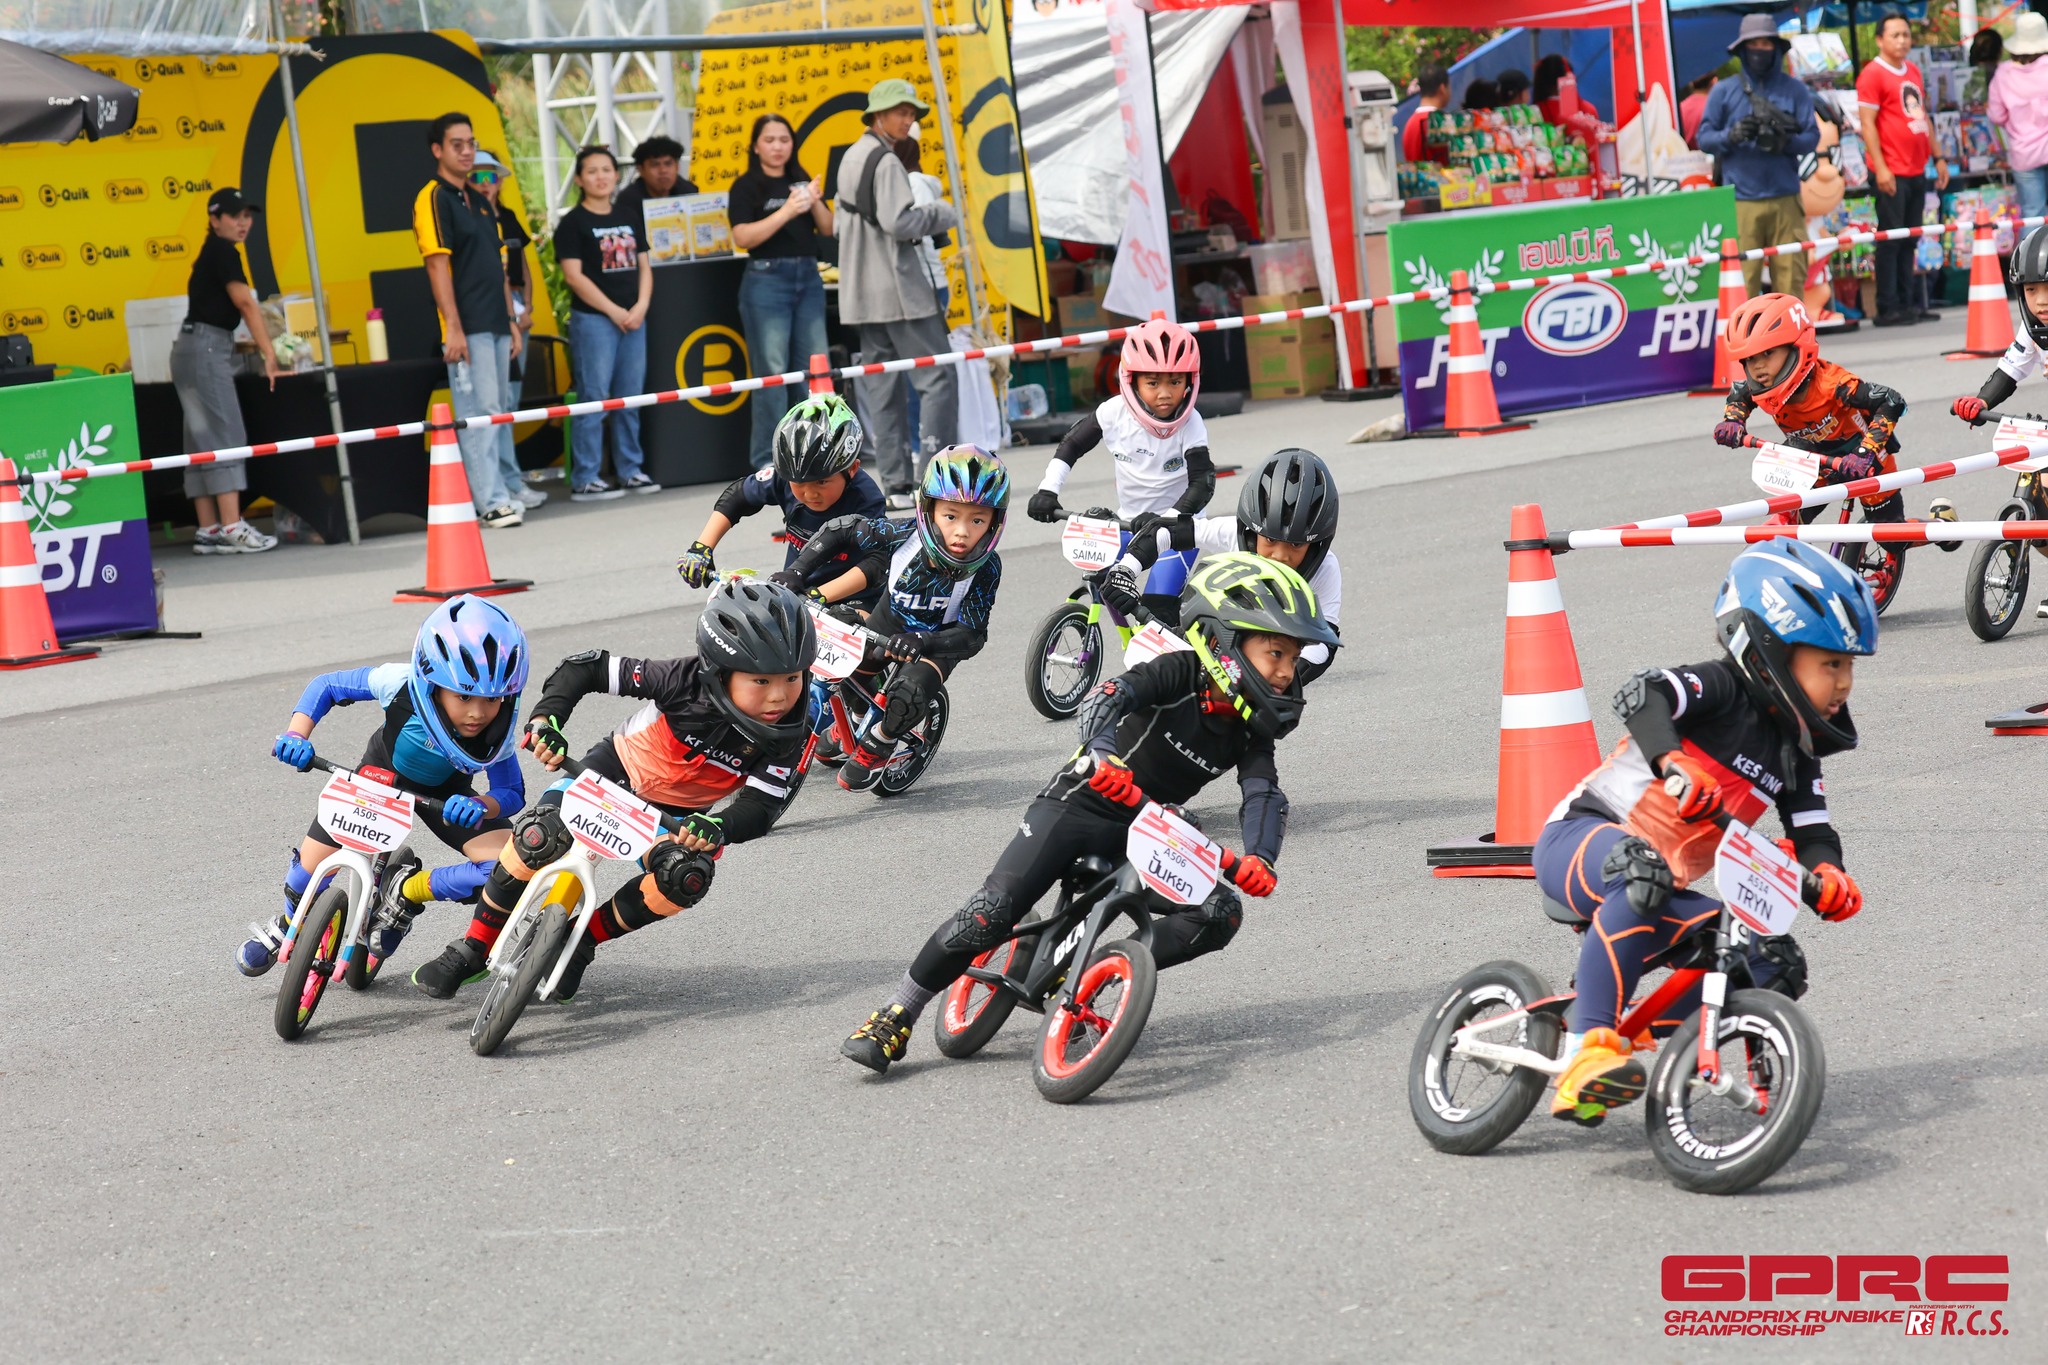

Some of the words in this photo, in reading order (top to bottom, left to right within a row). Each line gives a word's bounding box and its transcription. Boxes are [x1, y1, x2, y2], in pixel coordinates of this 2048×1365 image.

[737, 52, 769, 71] B-Quik
[778, 46, 810, 65] B-Quik
[879, 52, 913, 71] B-Quik
[135, 59, 185, 82] B-Quik
[796, 65, 828, 84] B-Quik
[838, 59, 870, 78] B-Quik
[713, 78, 745, 97] B-Quik
[754, 71, 787, 91] B-Quik
[733, 97, 766, 116] B-Quik
[775, 91, 807, 110] B-Quik
[177, 116, 225, 138] B-Quik
[709, 122, 742, 141] B-Quik
[39, 184, 89, 207] B-Quik
[106, 183, 143, 199] B-Quik
[163, 177, 212, 199] B-Quik
[80, 242, 130, 266] B-Quik
[146, 240, 184, 257] B-Quik
[22, 249, 60, 268] B-Quik
[3, 313, 43, 331] B-Quik
[64, 305, 115, 328] B-Quik
[1538, 295, 1610, 338] FBT
[1415, 326, 1511, 389] FT
[1072, 548, 1106, 562] SAIMAI
[700, 615, 737, 656] CRATONI
[1732, 753, 1763, 779] KES
[352, 807, 378, 822] A505
[595, 812, 620, 831] A508
[330, 812, 391, 845] Hunterz
[569, 814, 632, 855] AKIHITO
[1163, 848, 1187, 868] A506
[1148, 850, 1193, 898] ปั้นหยา
[1737, 882, 1773, 921] TRYN
